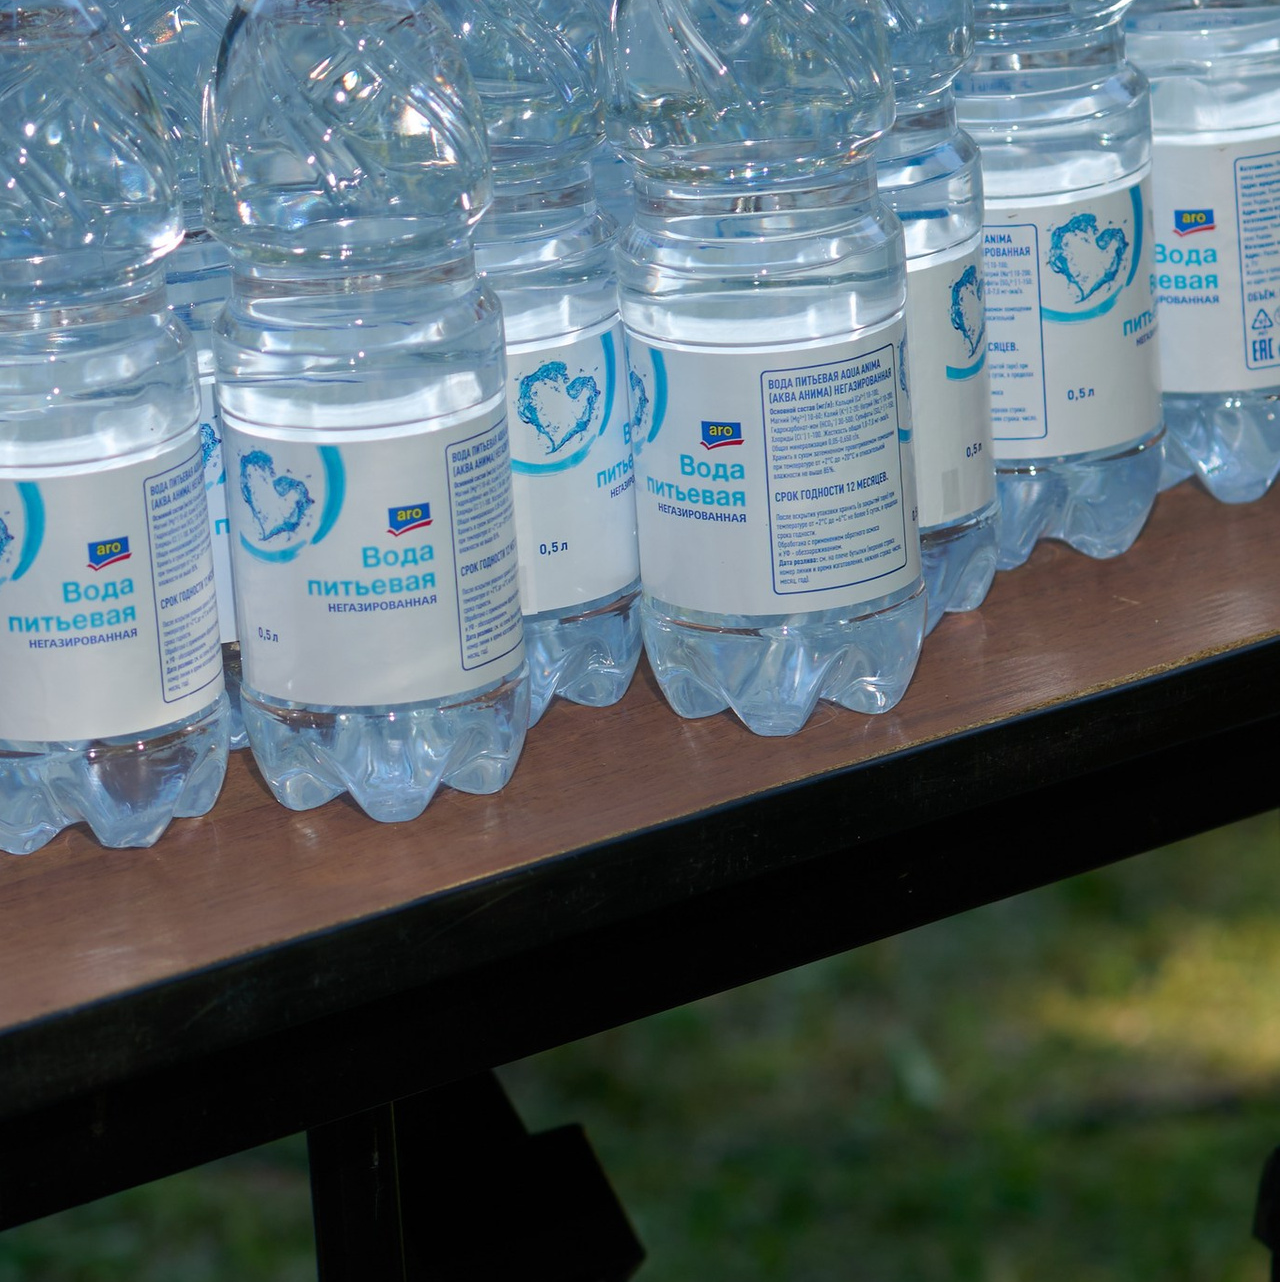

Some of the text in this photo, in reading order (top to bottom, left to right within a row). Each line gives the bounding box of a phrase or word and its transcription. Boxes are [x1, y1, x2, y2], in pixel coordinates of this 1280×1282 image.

[1182, 212, 1206, 224] aro
[984, 234, 1012, 244] ANIMA
[984, 246, 1030, 258] РОВАННАЯ
[1154, 243, 1218, 266] Вода
[1158, 294, 1220, 304] РОВАННАЯ
[988, 342, 1019, 353] СЯЦЕВ.
[768, 358, 881, 390] ВОДА ПИТЬЕВАЯ AQUA ANIMA
[769, 368, 892, 404] (АКВА АНИМА) НЕГАЗИРОВАННАЯ
[1067, 387, 1094, 401] 0,5 л
[709, 424, 734, 437] aro
[966, 442, 978, 458] 0,5
[596, 452, 634, 488] питье
[680, 453, 746, 482] Вода
[150, 480, 168, 496] ВОДА
[646, 475, 746, 508] питьевая
[775, 471, 889, 502] СРОК ГОДНОСТИ 12 МЕСЯЦЕВ.
[396, 507, 422, 522] aro
[658, 502, 747, 523] НЕГАЗИРОВАННАЯ
[96, 542, 122, 556] aro
[362, 544, 434, 568] Вода
[539, 541, 568, 556] 0,5 л
[460, 562, 480, 577] СРОК
[62, 578, 134, 604] Вода
[308, 572, 436, 596] питьевая
[160, 595, 178, 610] СРОК
[328, 594, 438, 612] НЕГАЗИРОВАННАЯ
[8, 605, 136, 633] питьевая
[28, 628, 138, 648] НЕГАЗИРОВАННАЯ
[258, 626, 271, 640] 0,5
